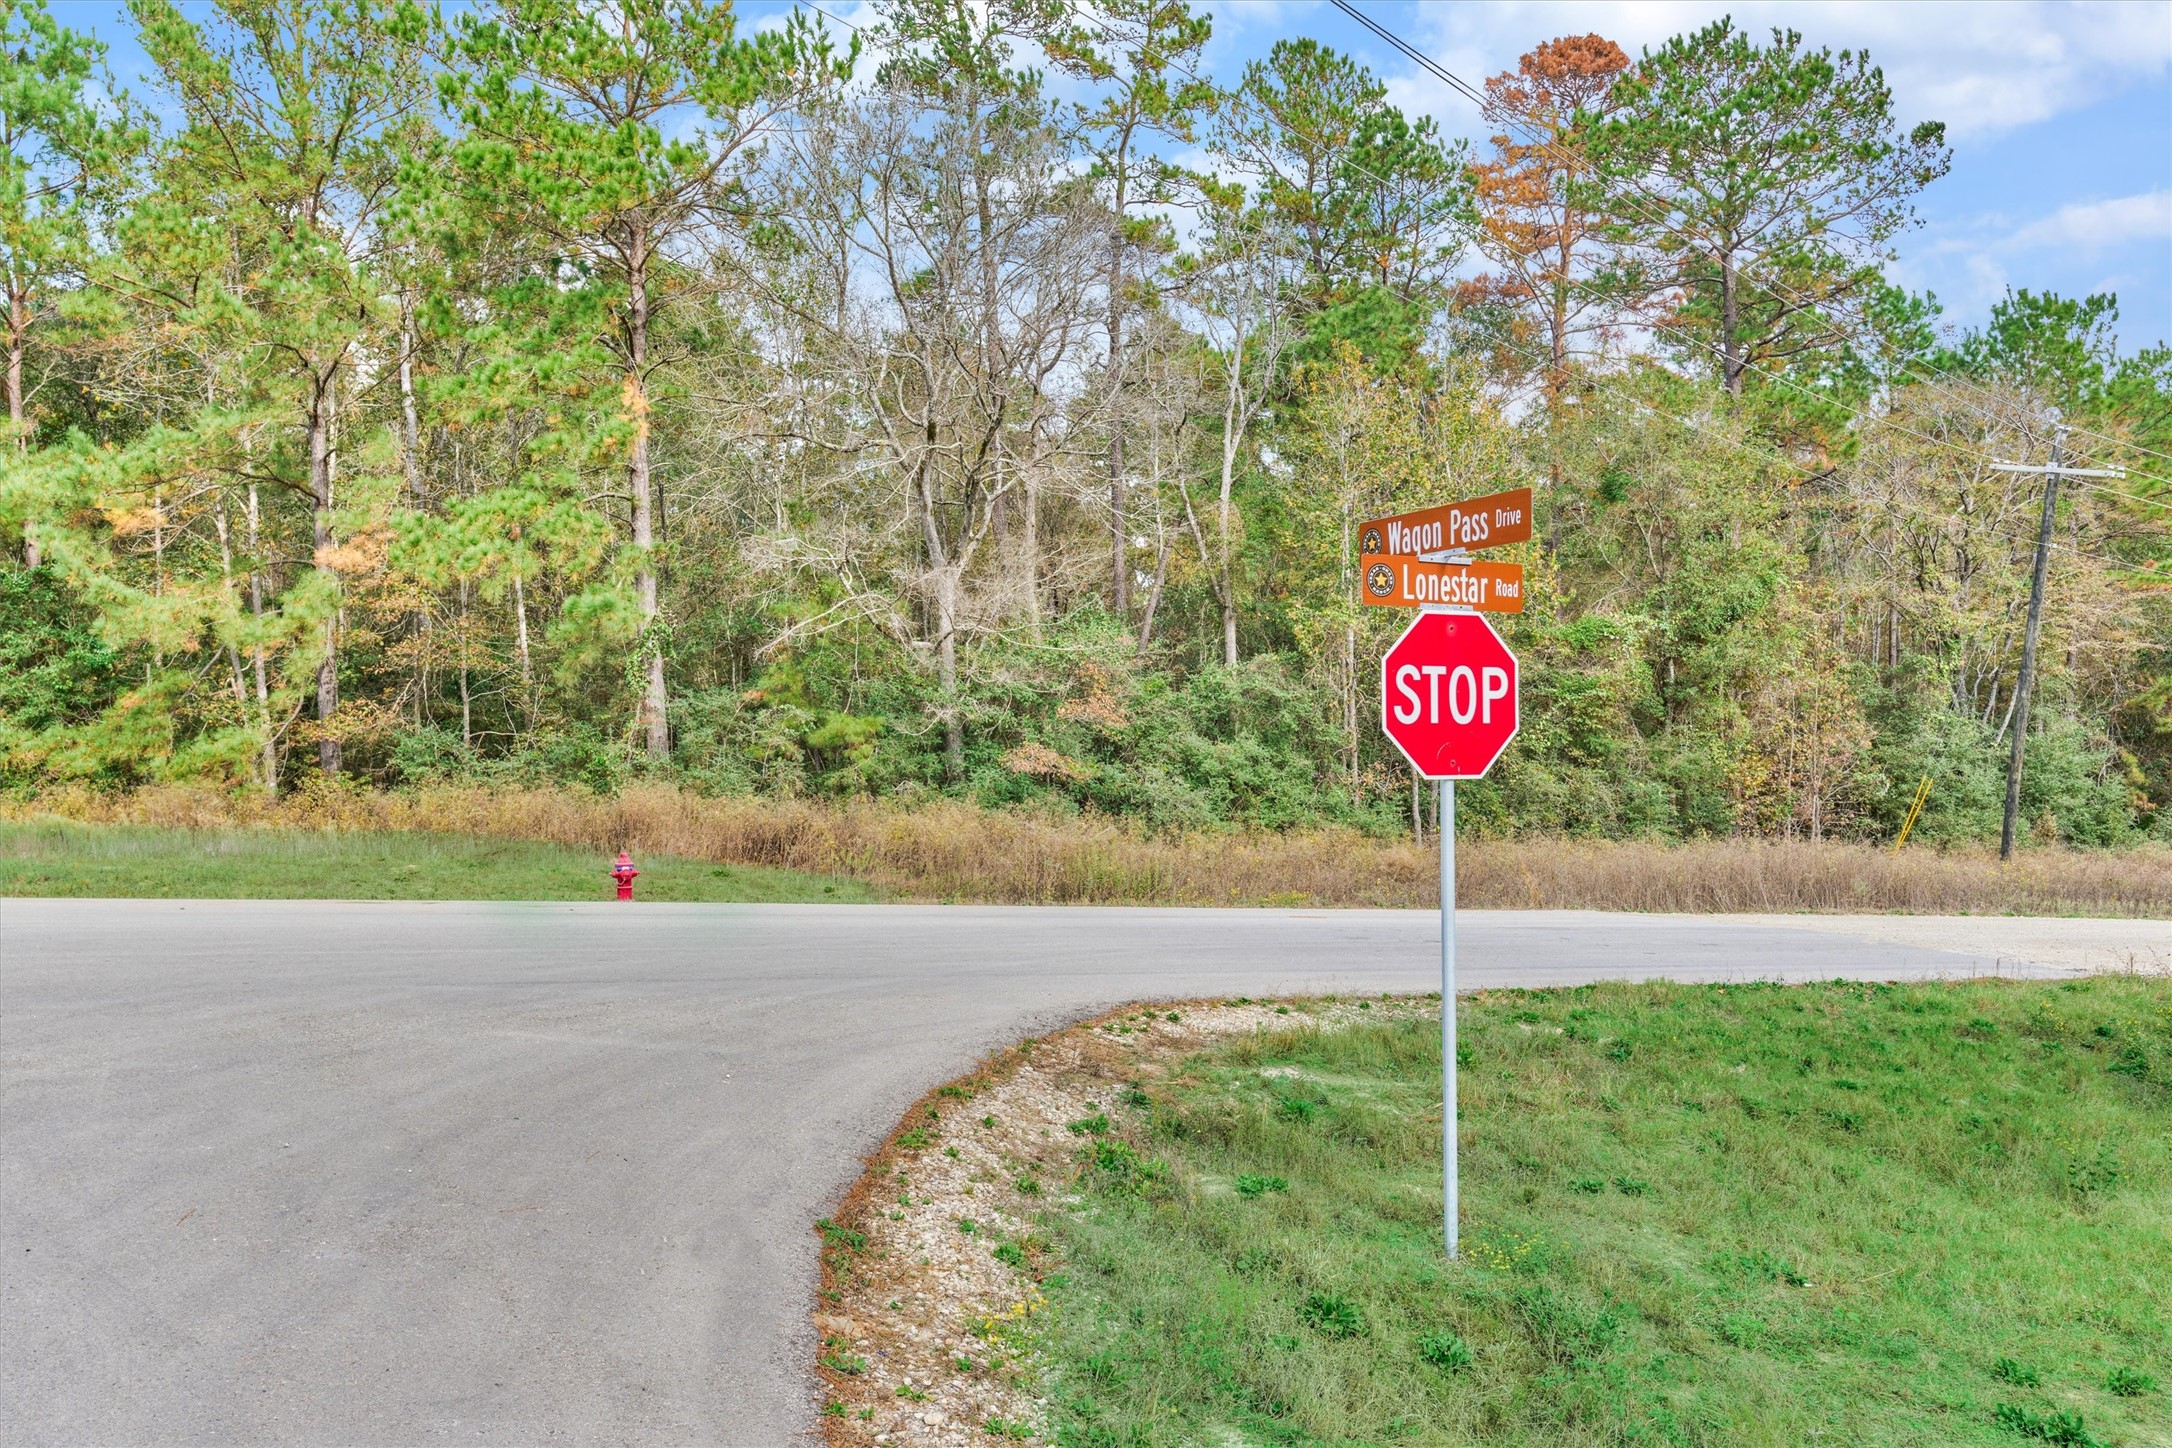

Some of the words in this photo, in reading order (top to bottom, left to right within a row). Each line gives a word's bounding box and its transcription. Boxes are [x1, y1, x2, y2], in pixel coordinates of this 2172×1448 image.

[1387, 520, 1442, 557] Wagon
[1450, 509, 1489, 544] Pass
[1495, 507, 1521, 528] Drive
[1403, 564, 1488, 603] Lonestar
[1495, 579, 1519, 597] Road
[1393, 664, 1509, 725] STOP
